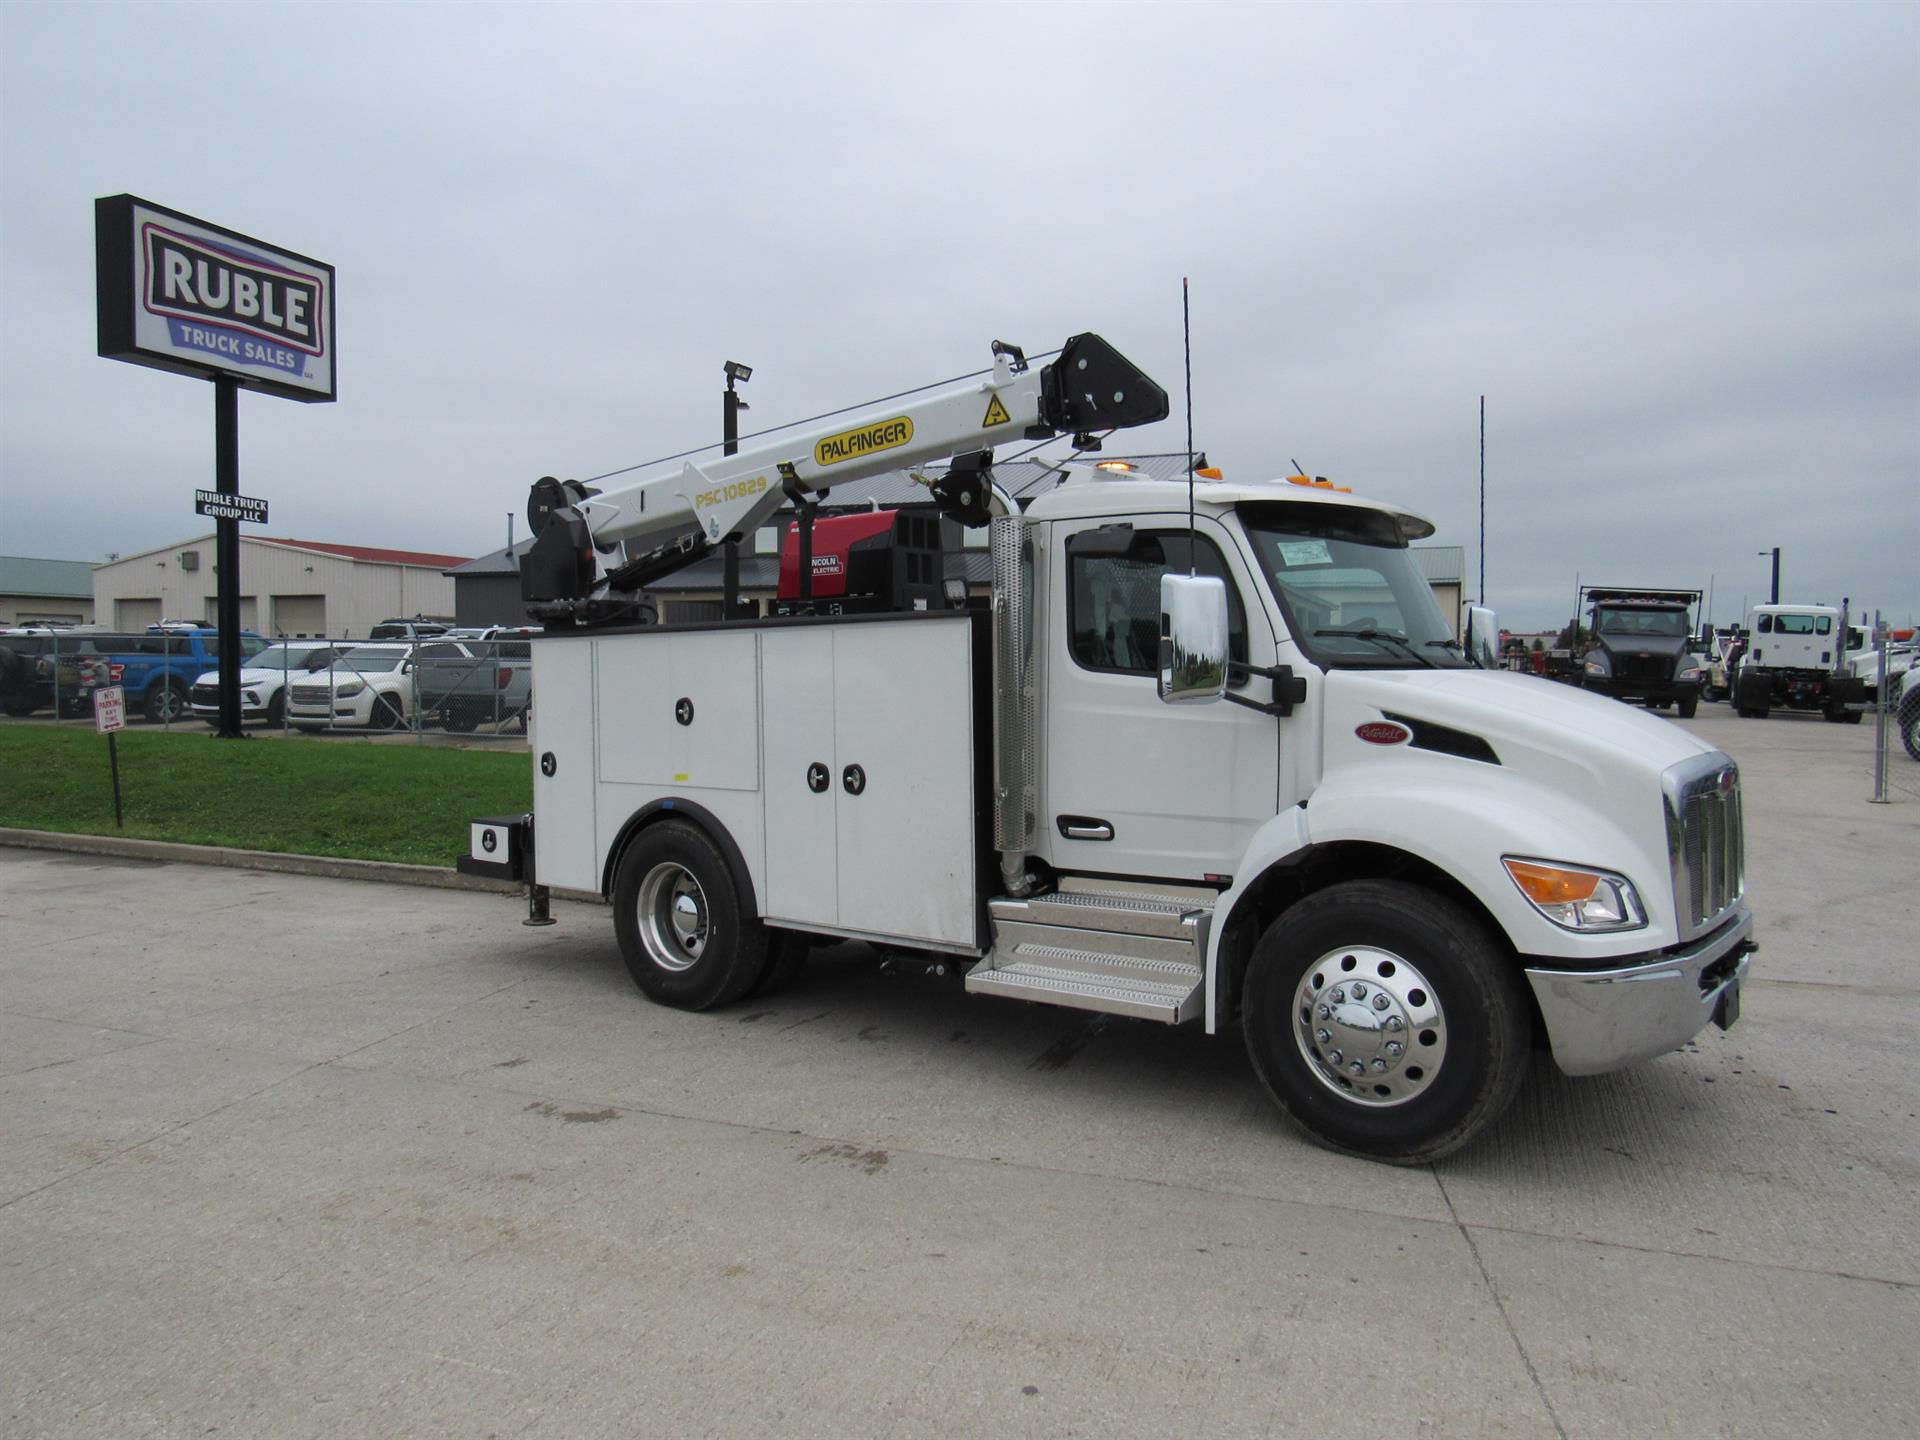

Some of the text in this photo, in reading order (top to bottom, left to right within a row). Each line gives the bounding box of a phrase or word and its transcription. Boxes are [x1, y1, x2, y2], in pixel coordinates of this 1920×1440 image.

[164, 247, 309, 336] RUBLE
[181, 325, 295, 369] TRUCK SALES
[820, 422, 907, 461] PALFINGER
[197, 491, 267, 511] RUBLE TRUCK
[204, 504, 261, 522] GROUP LLC
[812, 557, 836, 567] NCOLN
[813, 566, 840, 575] ELECTRIC
[97, 699, 122, 708] PARKING
[104, 690, 115, 699] NO
